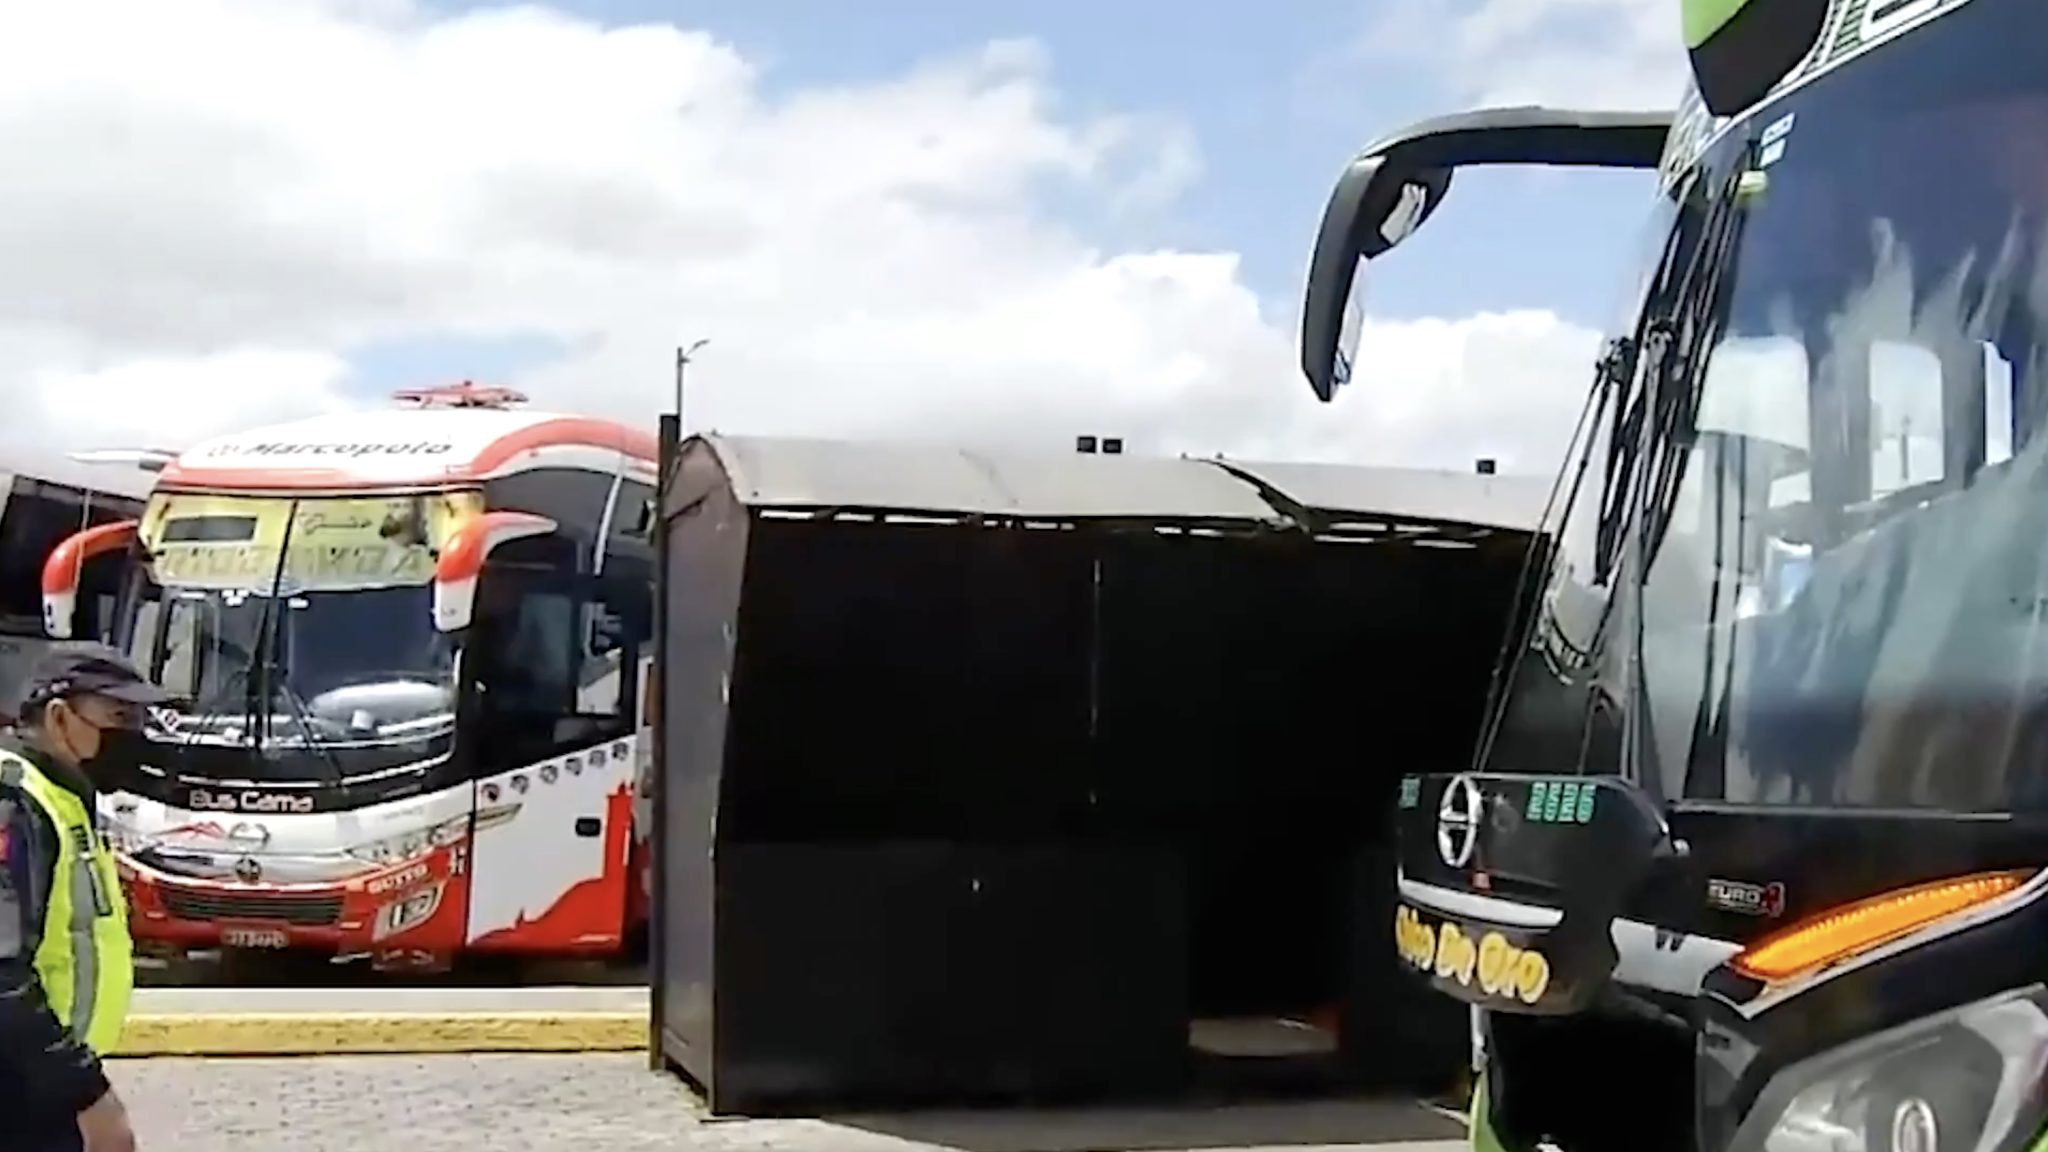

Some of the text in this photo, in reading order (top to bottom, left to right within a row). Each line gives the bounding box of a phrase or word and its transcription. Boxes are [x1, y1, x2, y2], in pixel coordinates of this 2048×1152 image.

[243, 440, 452, 458] Marcopolo
[189, 789, 314, 812] Bus Cama
[1478, 932, 1549, 1003] Oro
